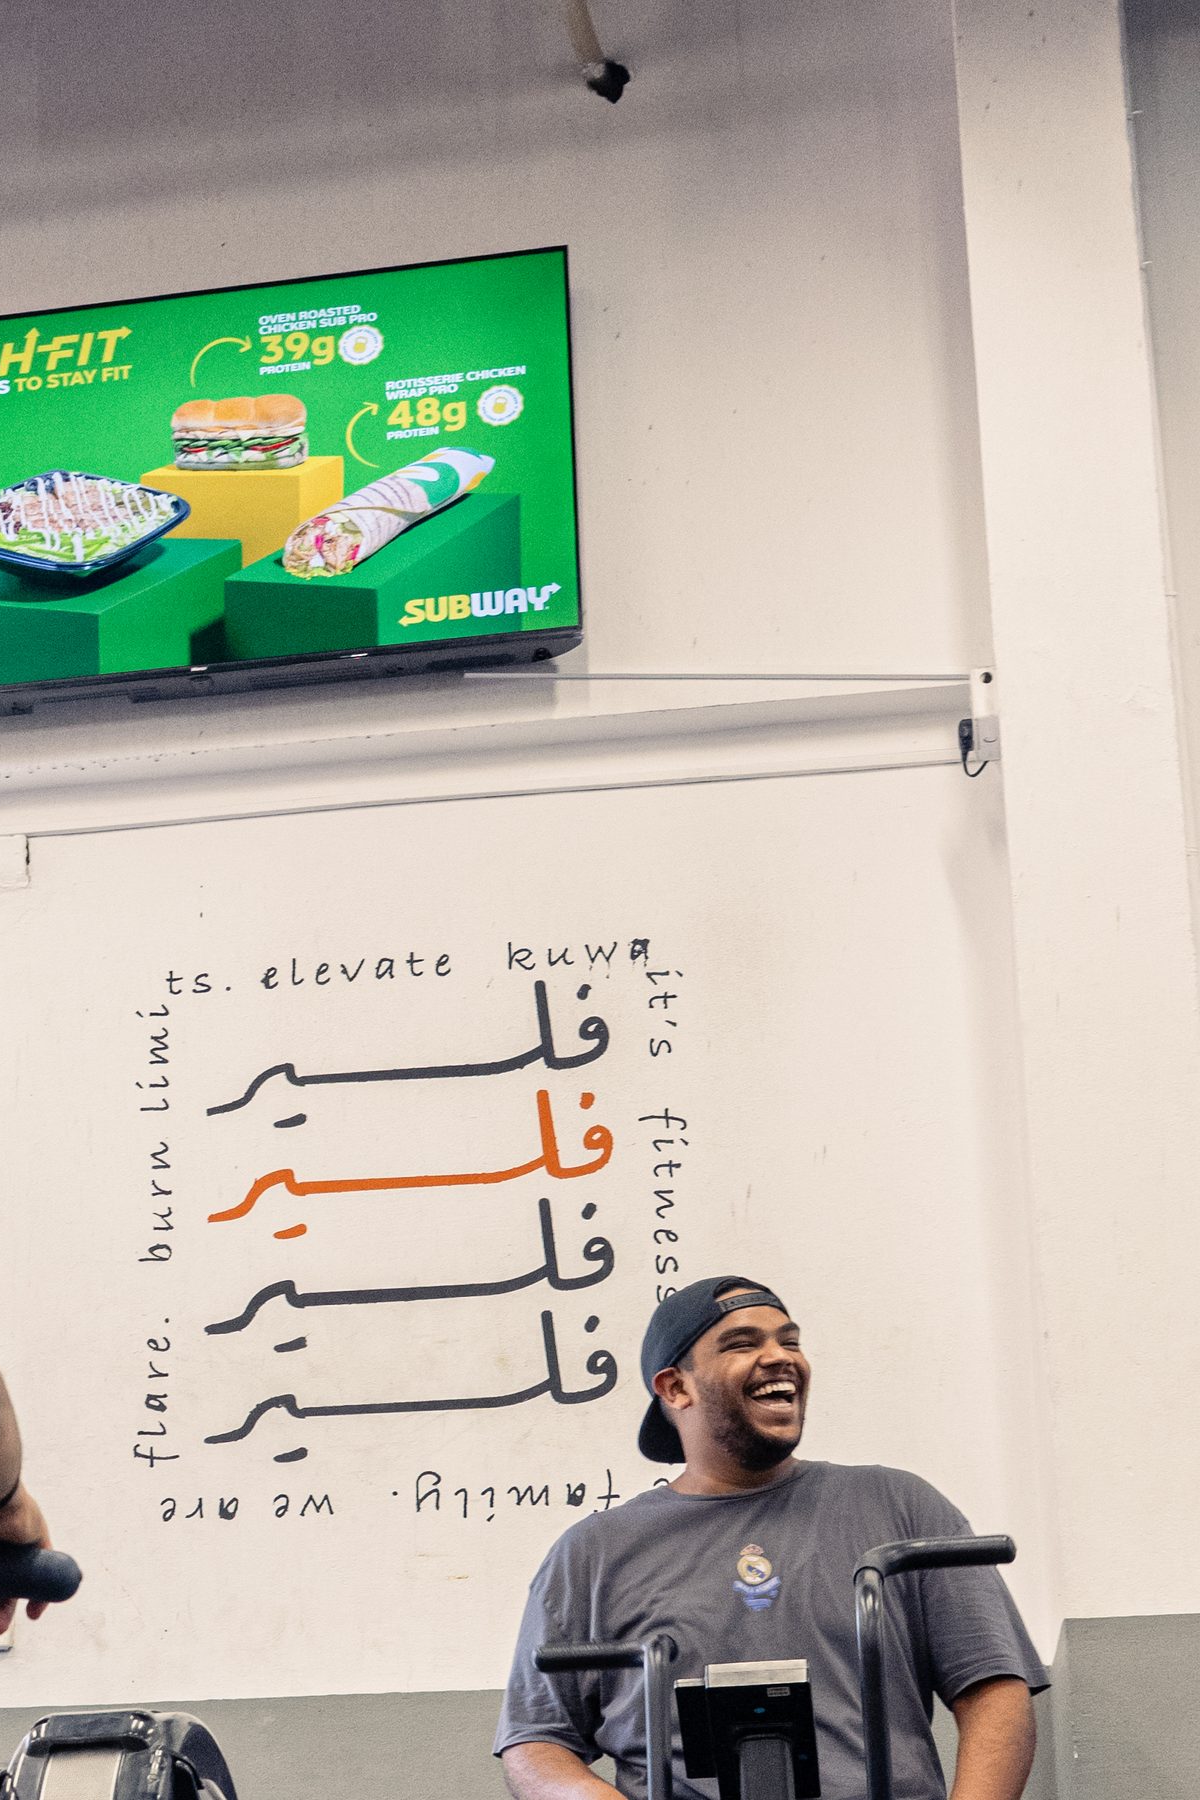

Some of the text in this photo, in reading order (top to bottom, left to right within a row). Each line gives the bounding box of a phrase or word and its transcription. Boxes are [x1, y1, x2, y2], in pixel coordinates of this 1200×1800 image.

[259, 305, 361, 325] OVEN ROASTED
[259, 312, 378, 335] CHICKEN SUB PRO
[260, 332, 335, 365] 39g
[14, 377, 42, 392] TO
[46, 369, 97, 388] STAY
[100, 365, 132, 382] FIT
[259, 362, 311, 375] PROTEIN
[385, 365, 526, 390] ROTISSERIE CHICKEN
[386, 384, 458, 400] WRAP PRO
[387, 397, 466, 432] 48g
[386, 426, 439, 440] PROTEIN
[398, 582, 561, 627] SUBWAY
[260, 951, 451, 990] elevate
[507, 938, 650, 970] kuwa
[138, 1142, 174, 1262] burn
[133, 1317, 180, 1468] flare.
[160, 1496, 239, 1522] are
[273, 1494, 335, 1518] we
